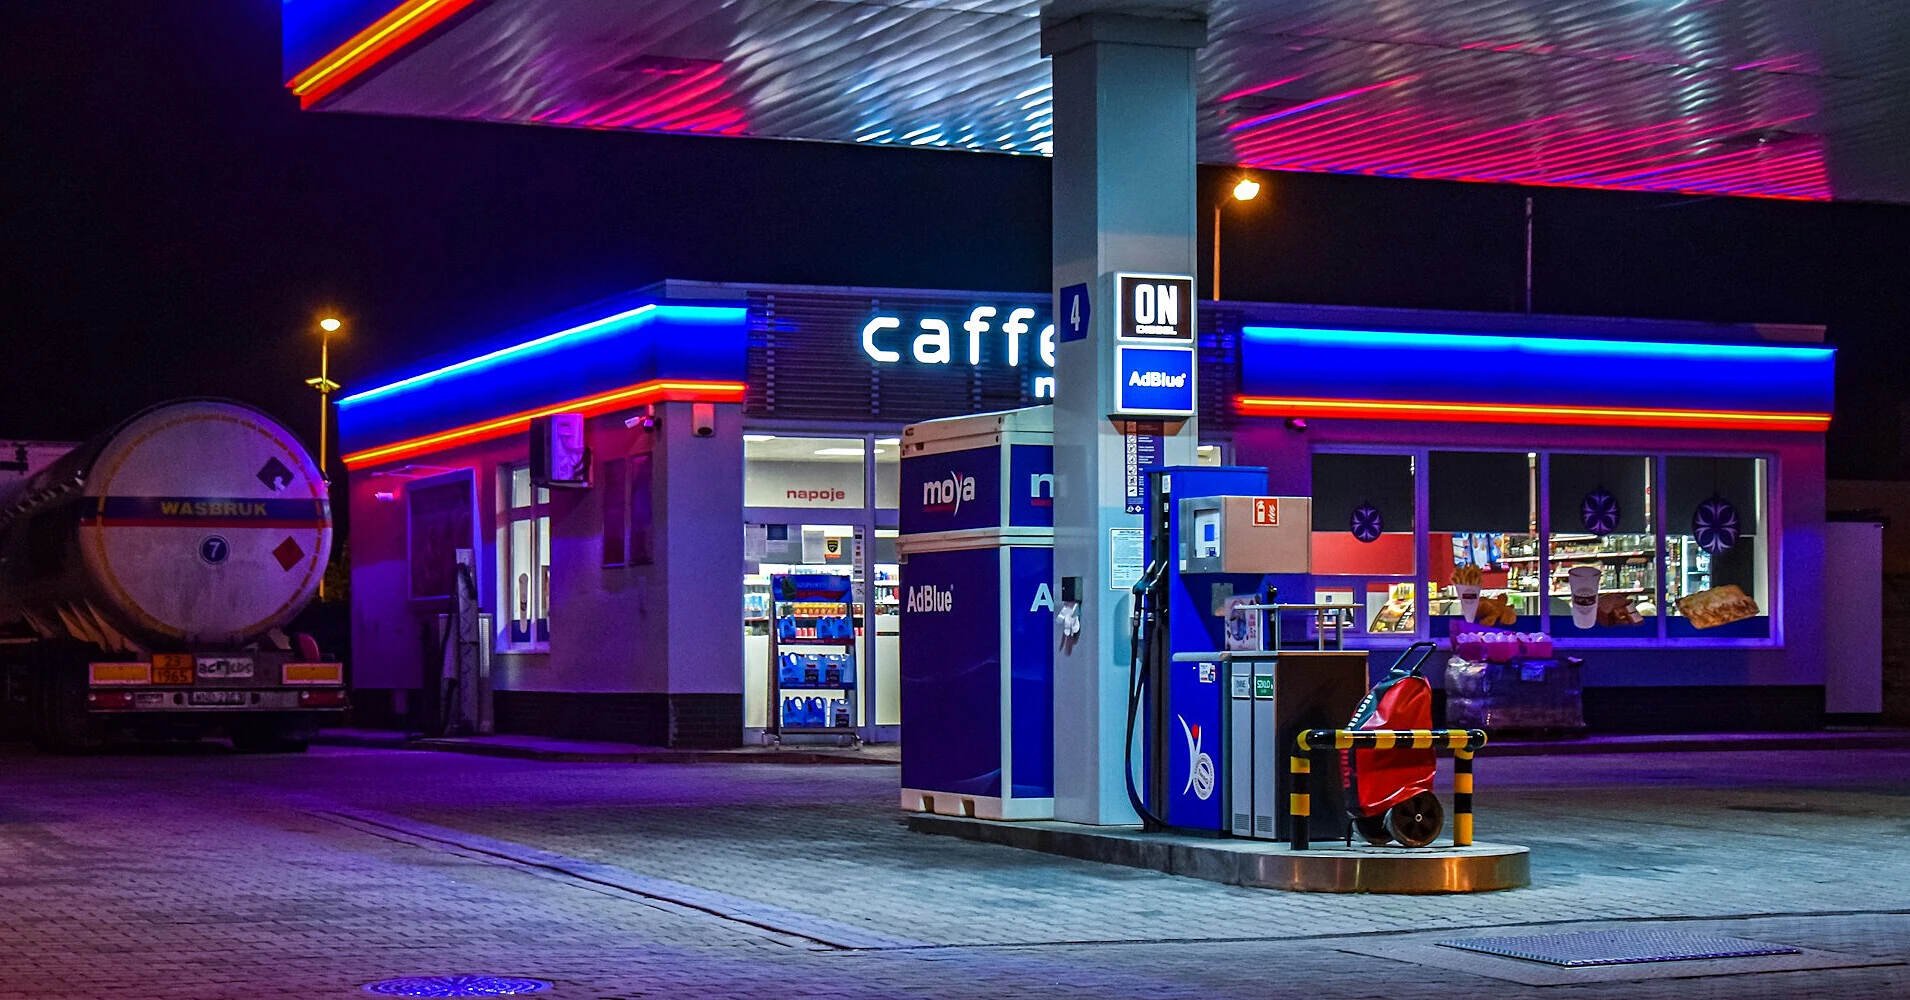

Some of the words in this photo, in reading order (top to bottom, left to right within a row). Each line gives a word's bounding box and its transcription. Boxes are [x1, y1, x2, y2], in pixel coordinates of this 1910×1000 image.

[1135, 283, 1178, 325] ON
[1070, 294, 1081, 332] 4
[786, 487, 846, 503] napoje
[923, 470, 976, 517] moya
[160, 501, 268, 516] WASBRUK
[208, 541, 221, 559] 7
[164, 655, 181, 667] 23
[157, 670, 188, 682] 1965
